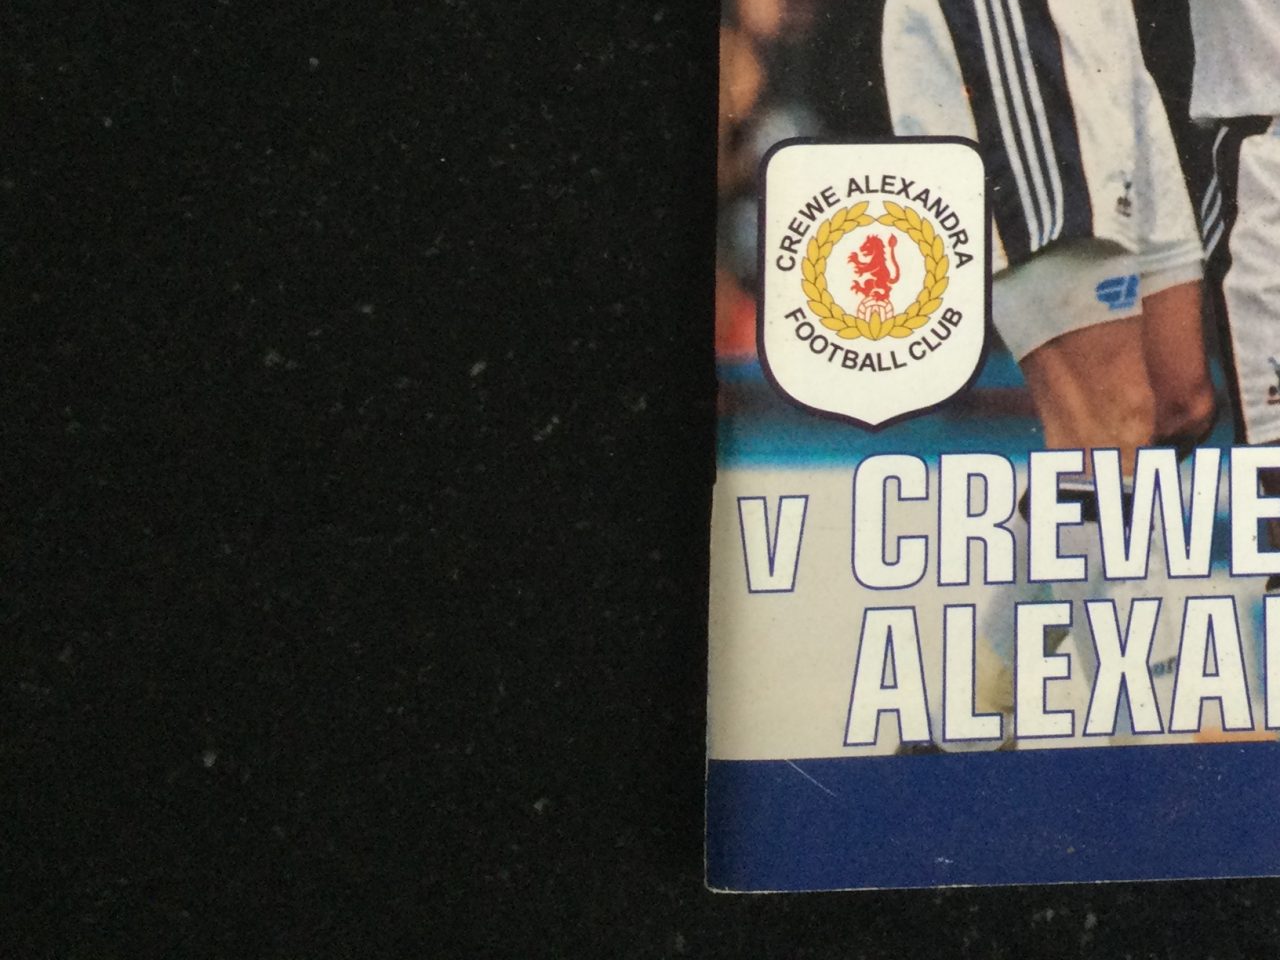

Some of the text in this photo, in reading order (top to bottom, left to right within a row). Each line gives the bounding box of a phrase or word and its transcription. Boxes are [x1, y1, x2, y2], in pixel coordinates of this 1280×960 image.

[776, 174, 974, 272] CREWE ALEXANDRA
[784, 307, 964, 373] FOOTBALL CLUB
